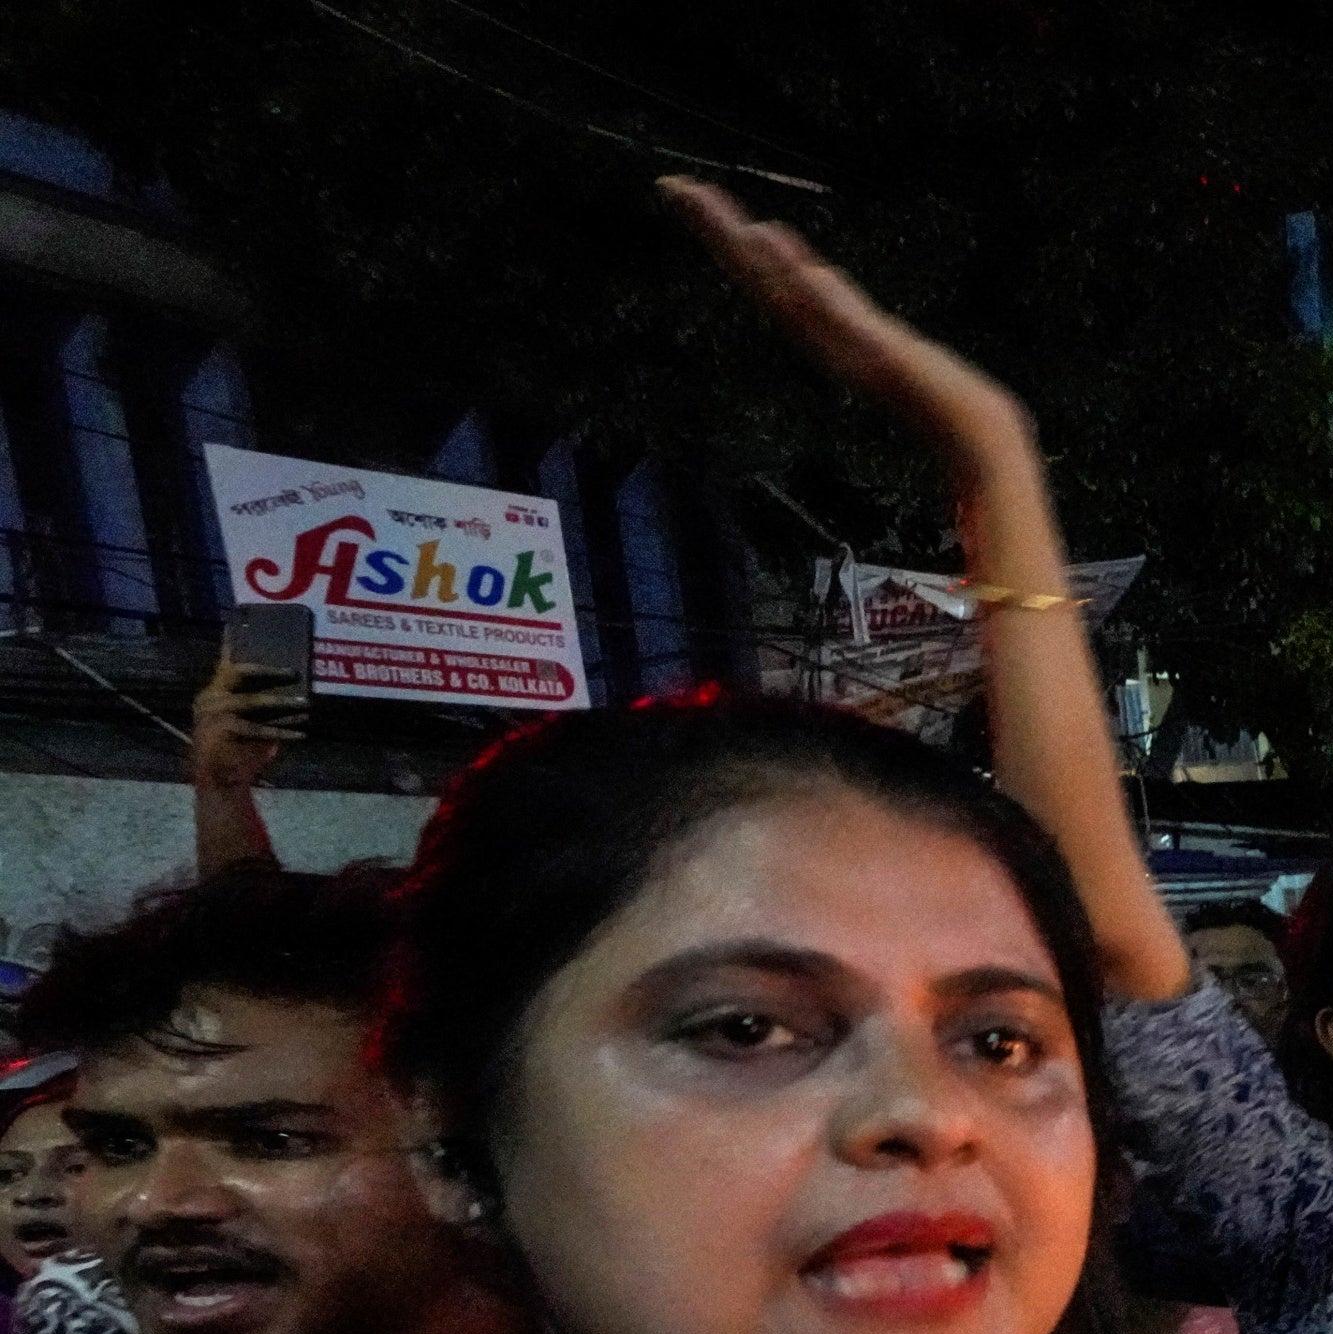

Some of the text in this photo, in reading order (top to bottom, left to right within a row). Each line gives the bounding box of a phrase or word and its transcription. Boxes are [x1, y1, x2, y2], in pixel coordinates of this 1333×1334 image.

[386, 508, 492, 541] অশোক শাড়ি
[244, 515, 557, 614] Ashok
[327, 610, 566, 648] SAREES & TEXTILE PRODUCTS
[314, 659, 567, 697] SAL BROTHERS & CO. KOLKATA
[429, 653, 440, 665] &
[445, 655, 531, 673] WHOLESALER
